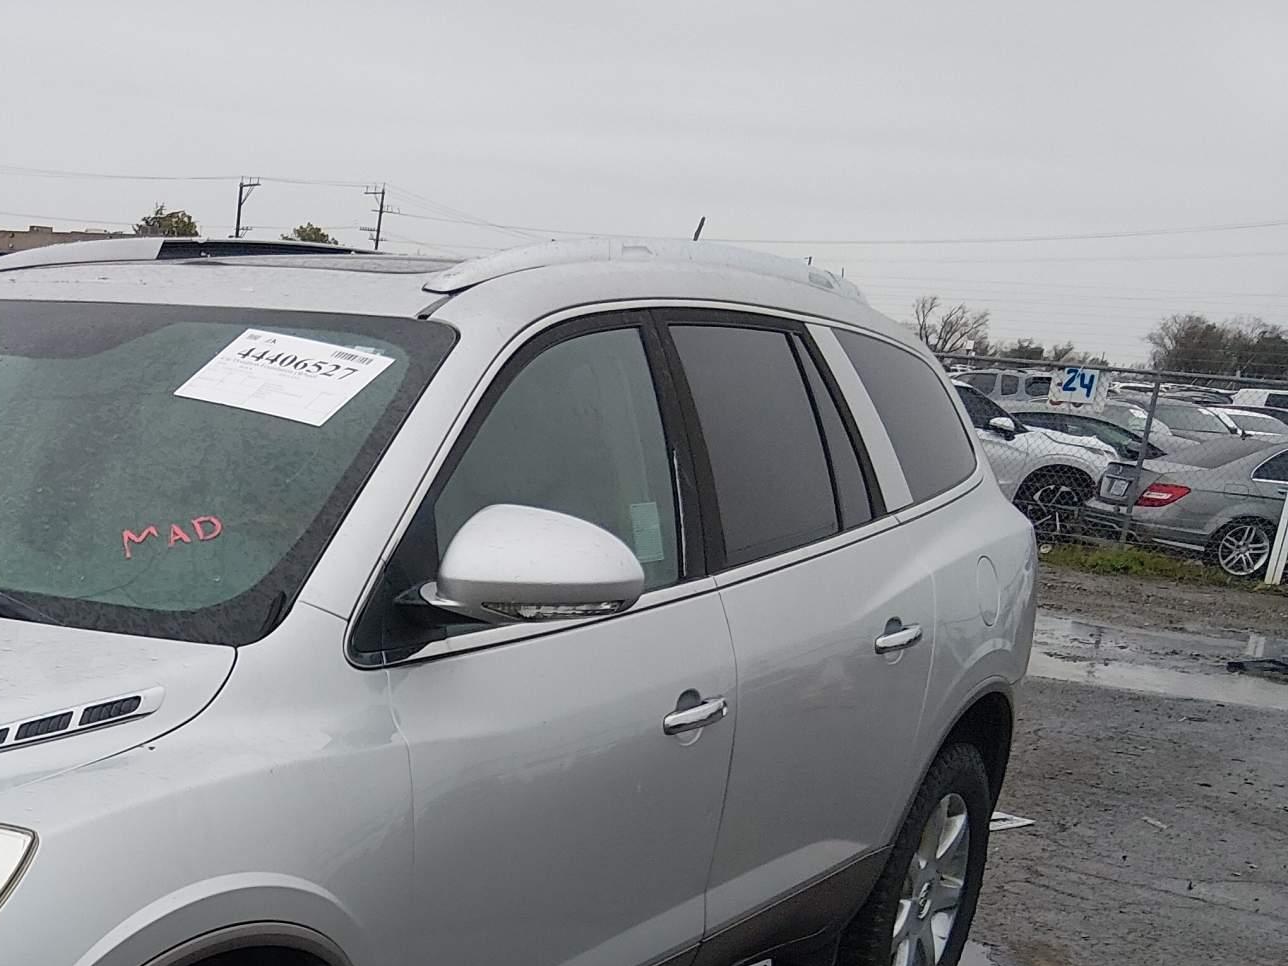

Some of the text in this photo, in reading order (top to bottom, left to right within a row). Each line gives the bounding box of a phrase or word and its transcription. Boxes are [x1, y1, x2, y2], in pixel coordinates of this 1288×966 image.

[237, 347, 359, 380] 44406527
[1062, 368, 1095, 398] 24
[122, 515, 224, 560] MAD
